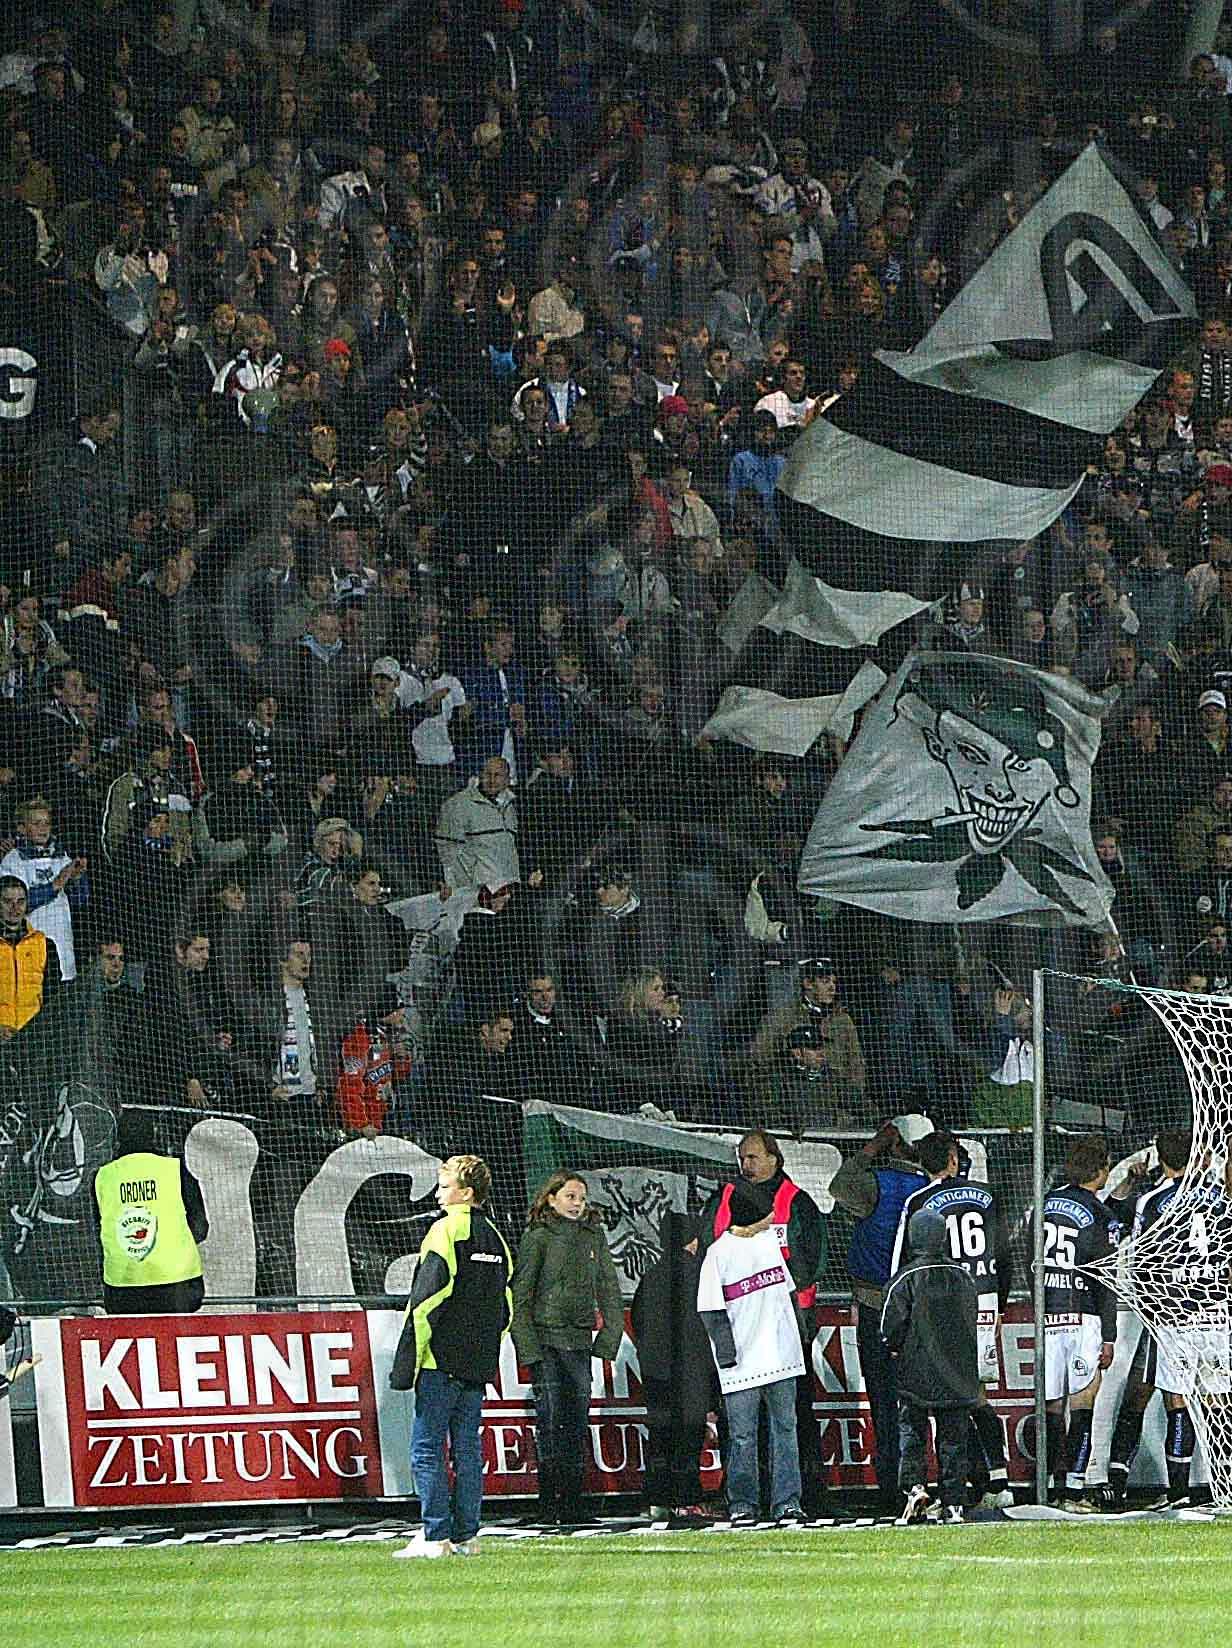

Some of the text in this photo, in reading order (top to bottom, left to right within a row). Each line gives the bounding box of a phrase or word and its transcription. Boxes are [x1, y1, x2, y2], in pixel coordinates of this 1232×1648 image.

[120, 1180, 157, 1204] ORDNER
[945, 1211, 986, 1259] 16
[1044, 1222, 1079, 1270] 25
[80, 1332, 360, 1411] KLEINE
[88, 1427, 369, 1488] ZEITUNG
